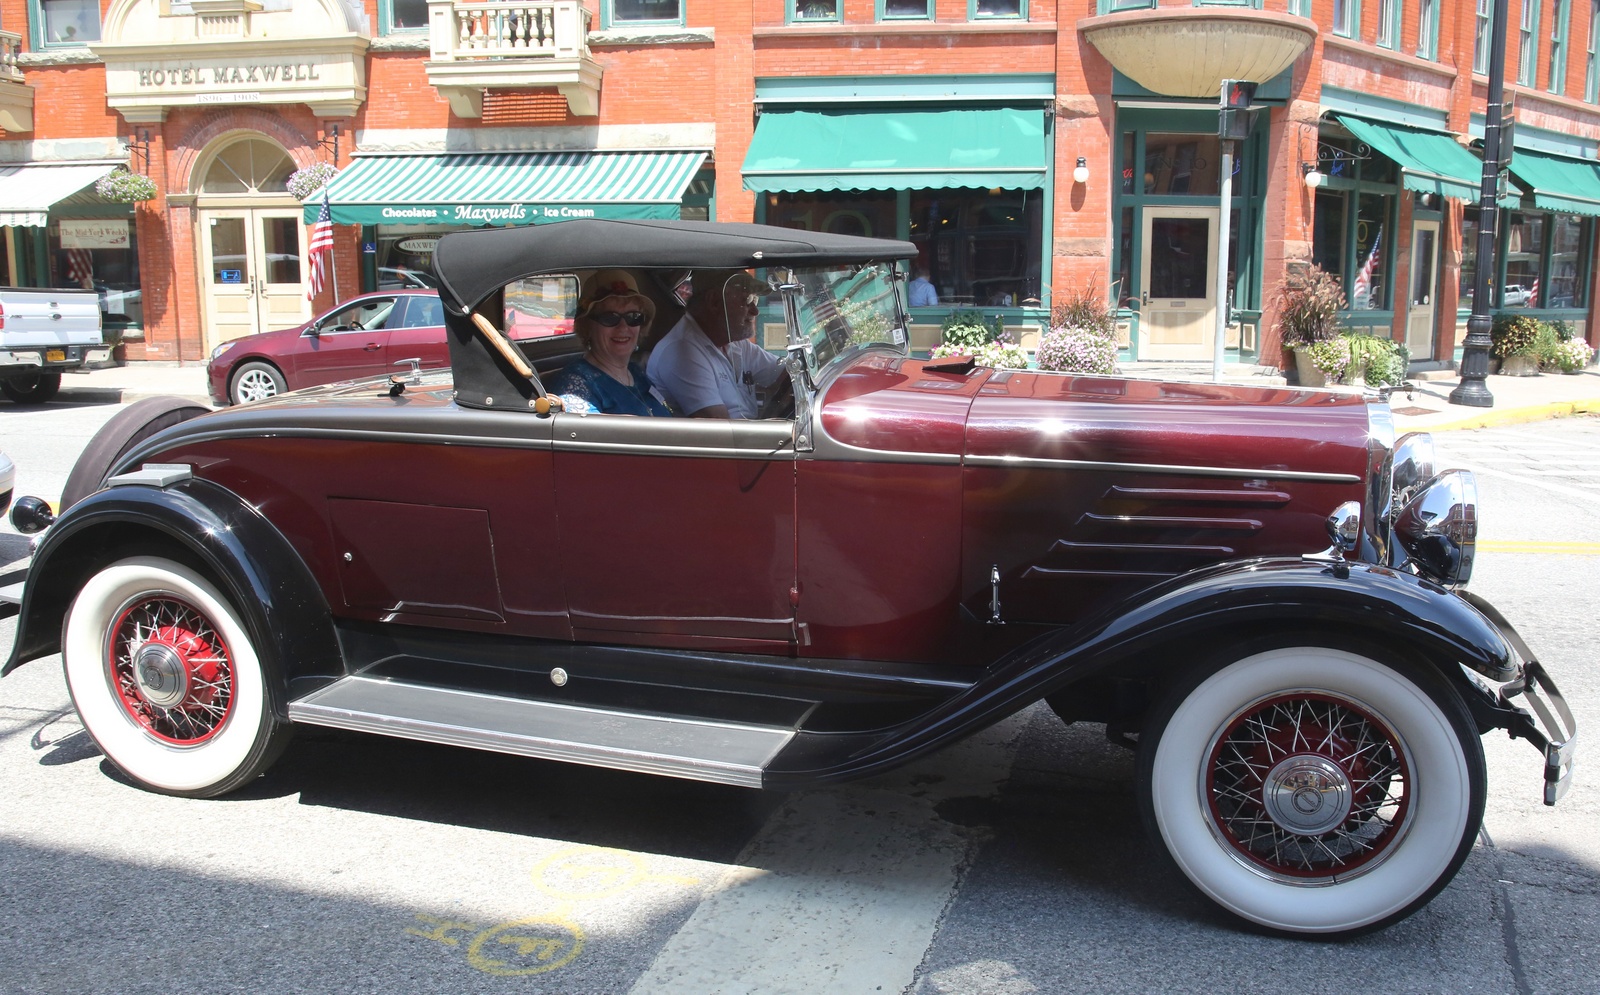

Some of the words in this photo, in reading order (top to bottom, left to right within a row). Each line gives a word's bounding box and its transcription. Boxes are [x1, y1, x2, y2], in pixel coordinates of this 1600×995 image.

[139, 67, 205, 86] HOTEL
[213, 63, 320, 84] MAXWELL
[233, 93, 258, 102] 1908
[381, 207, 437, 218] Chocolates
[454, 203, 527, 222] Maxwells
[543, 207, 559, 217] Ice
[560, 207, 595, 217] Cream
[61, 228, 74, 236] The
[105, 228, 128, 237] Weekly
[404, 241, 436, 249] MAXWE
